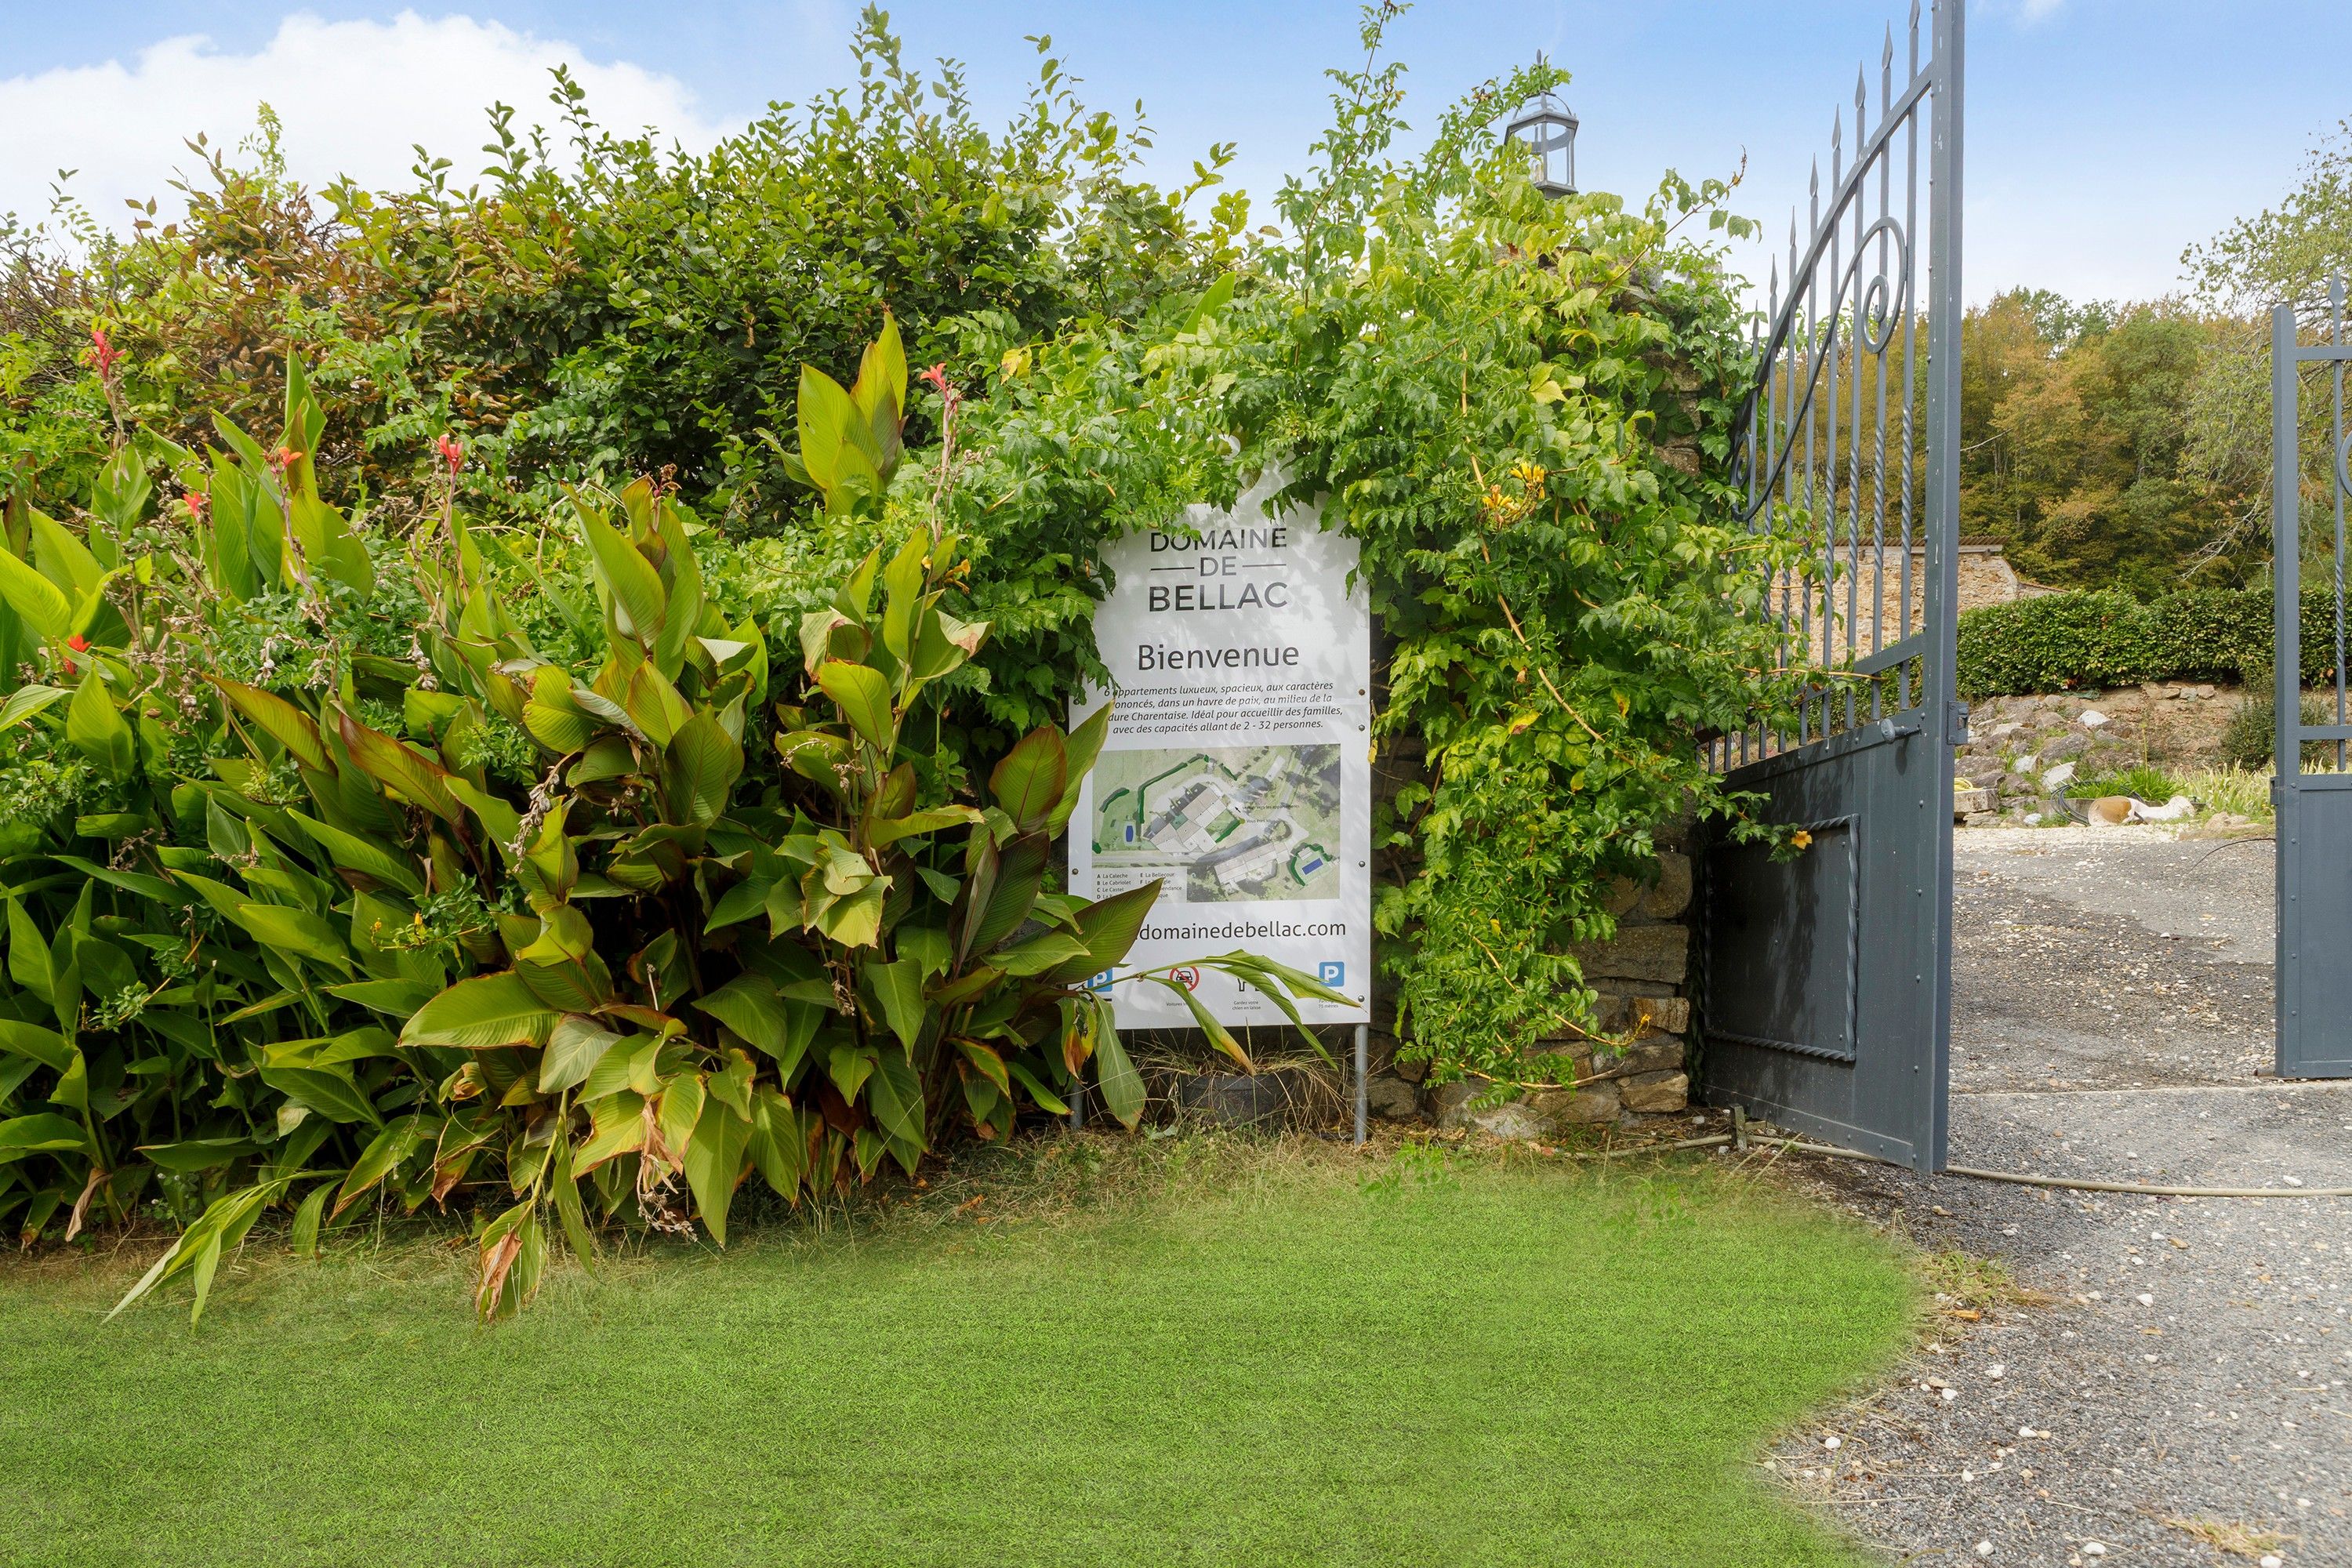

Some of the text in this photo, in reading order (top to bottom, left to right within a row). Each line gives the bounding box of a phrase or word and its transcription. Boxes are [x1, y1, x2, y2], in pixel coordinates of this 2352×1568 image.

[1150, 528, 1287, 552] DOMAINE
[1200, 556, 1236, 576] DE
[1149, 583, 1287, 612] BELLAC
[1138, 644, 1299, 670] Bienvenue
[1179, 685, 1218, 695] luxueux,
[1221, 684, 1264, 695] spacieux,
[1286, 681, 1334, 691] caractères
[1115, 699, 1156, 709] ononcés,
[1158, 699, 1180, 707] dans
[1197, 698, 1223, 706] havre
[1225, 697, 1236, 706] de
[1239, 697, 1261, 707] paix,
[1278, 695, 1307, 703] milieu
[1309, 694, 1321, 702] de
[1323, 694, 1332, 702] la
[1108, 706, 1343, 721] dure Charentaise. Idéal pour accueillir des familles,
[1136, 724, 1152, 733] des
[1154, 723, 1198, 735] capacités
[1200, 721, 1228, 731] allant
[1230, 721, 1241, 731] de
[1244, 721, 1250, 730] 2
[1258, 720, 1271, 730] 32
[1272, 720, 1323, 731] personnes.
[1139, 921, 1346, 940] domainedebellac.com
